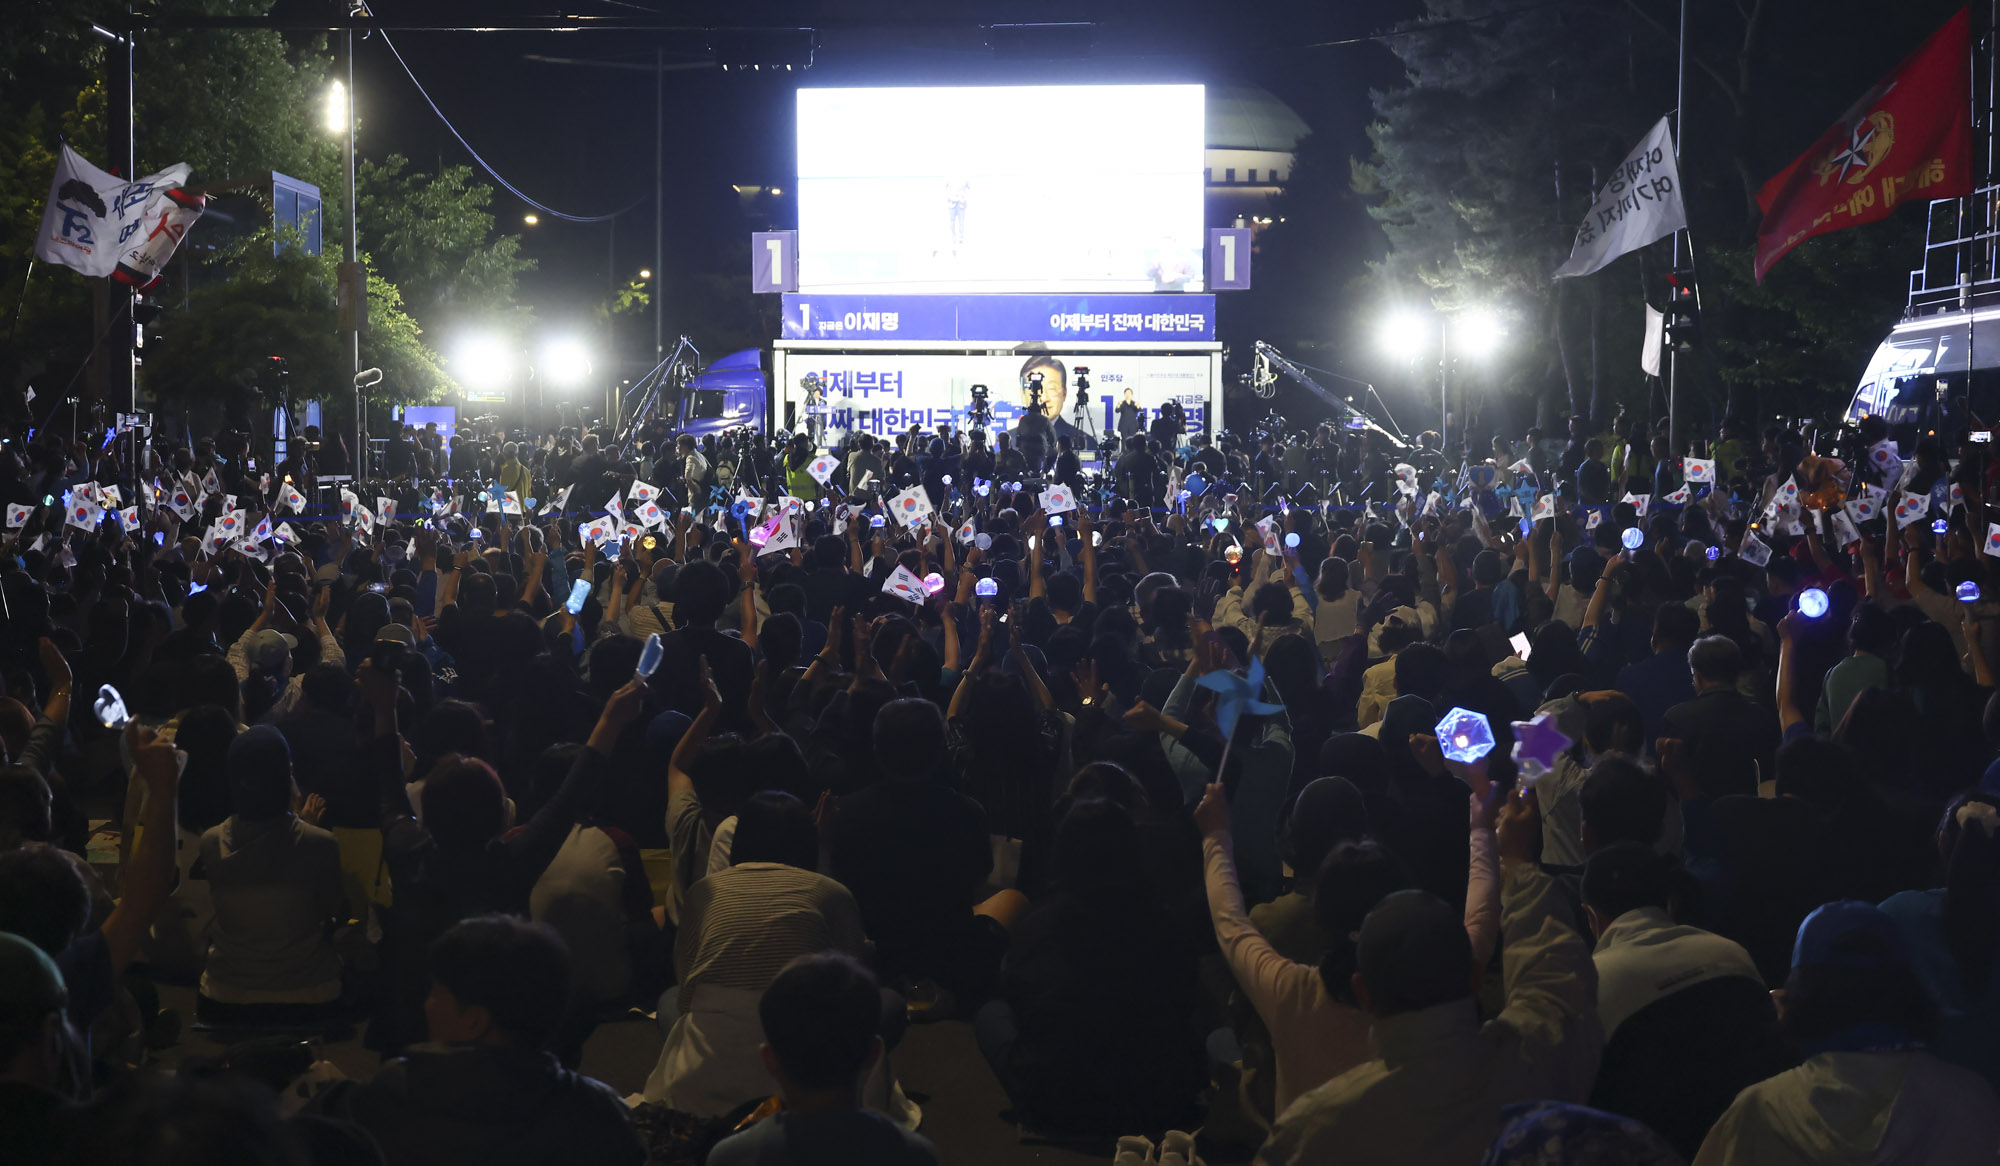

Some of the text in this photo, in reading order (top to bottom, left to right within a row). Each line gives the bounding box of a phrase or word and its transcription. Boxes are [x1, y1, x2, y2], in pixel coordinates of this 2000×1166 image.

[766, 239, 782, 285] 1
[1220, 235, 1236, 281] 1
[799, 303, 811, 331] 1
[844, 311, 899, 331] 이재명
[1050, 313, 1206, 332] 이제부터 진짜 대한민국
[1100, 374, 1124, 383] 민주당
[1100, 395, 1114, 431] 1
